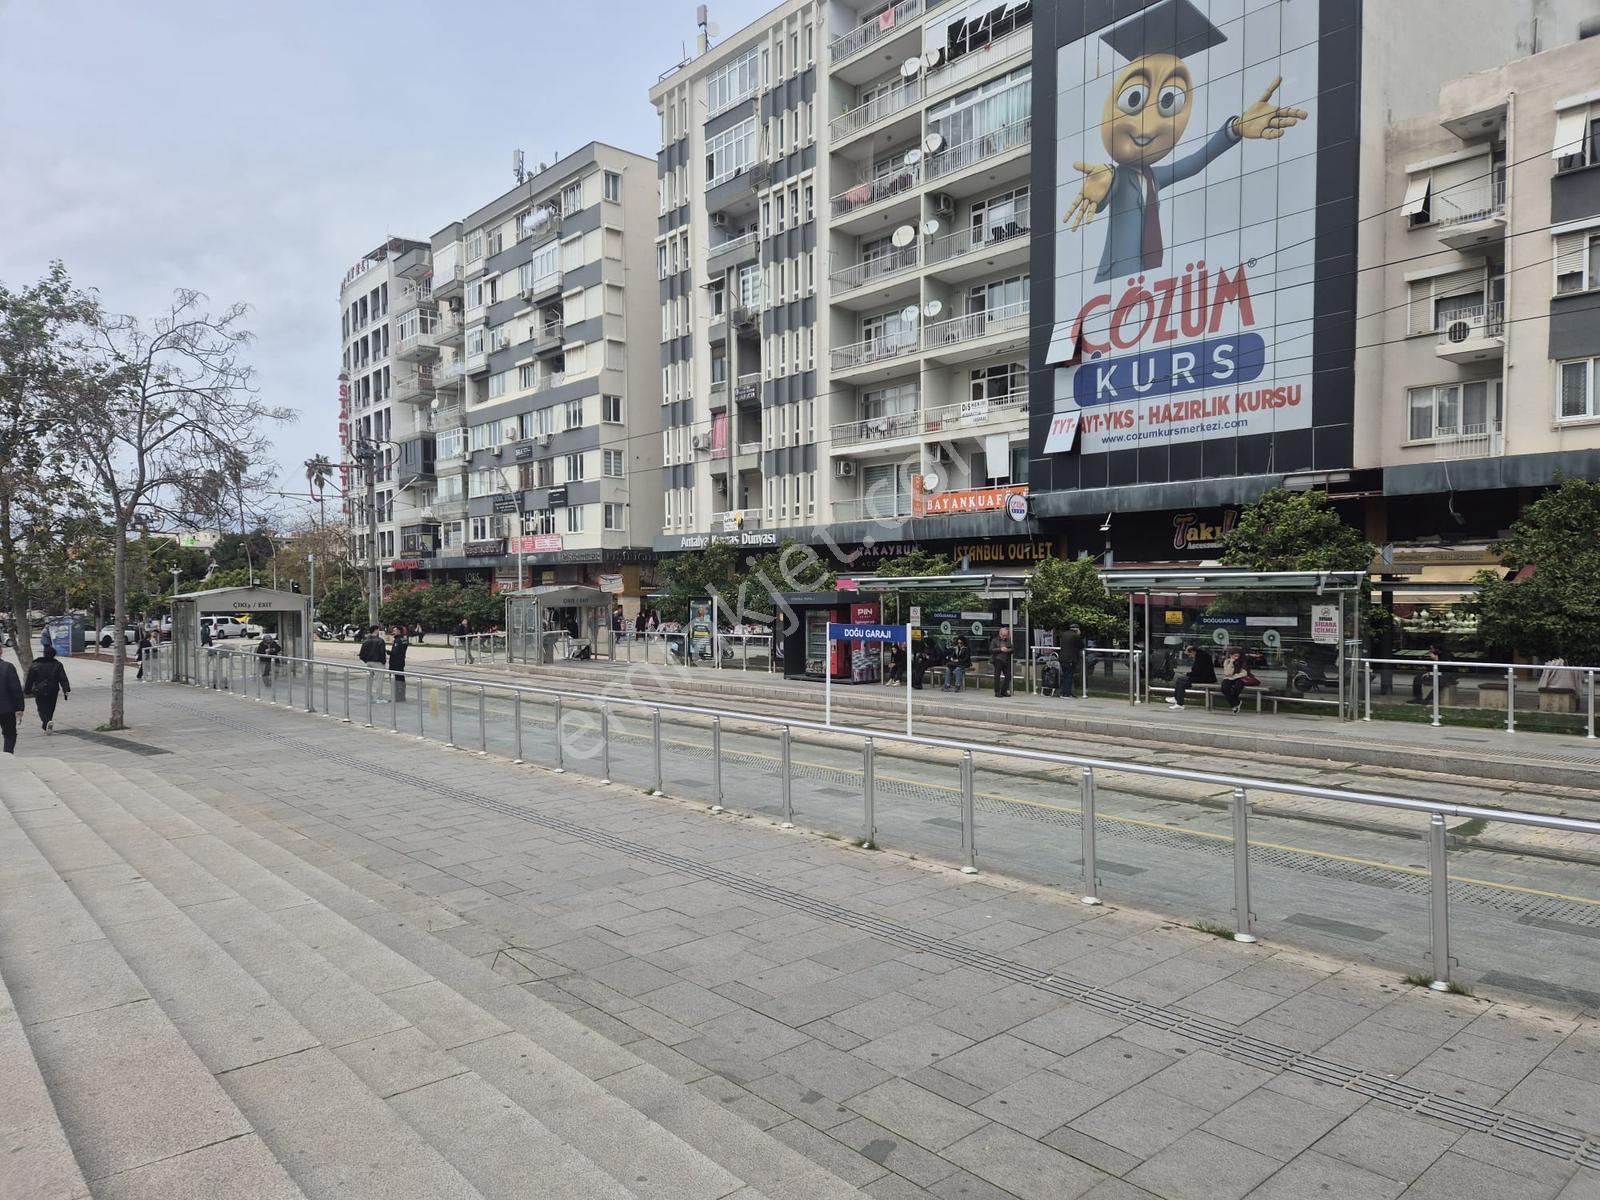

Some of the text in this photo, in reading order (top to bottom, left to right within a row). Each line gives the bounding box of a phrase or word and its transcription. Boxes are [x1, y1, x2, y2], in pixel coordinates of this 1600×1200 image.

[1095, 344, 1234, 399] KURS
[1148, 394, 1230, 425] HAZIRLIK
[1235, 384, 1302, 413] KURSU
[1101, 418, 1249, 445] www.cozumkursmerkezi.com
[680, 537, 709, 549] Antalya
[741, 531, 776, 546] Dünyası
[1008, 541, 1053, 560] OUTLET
[857, 608, 873, 616] PIN
[844, 628, 891, 639] DOĞU GARAJI
